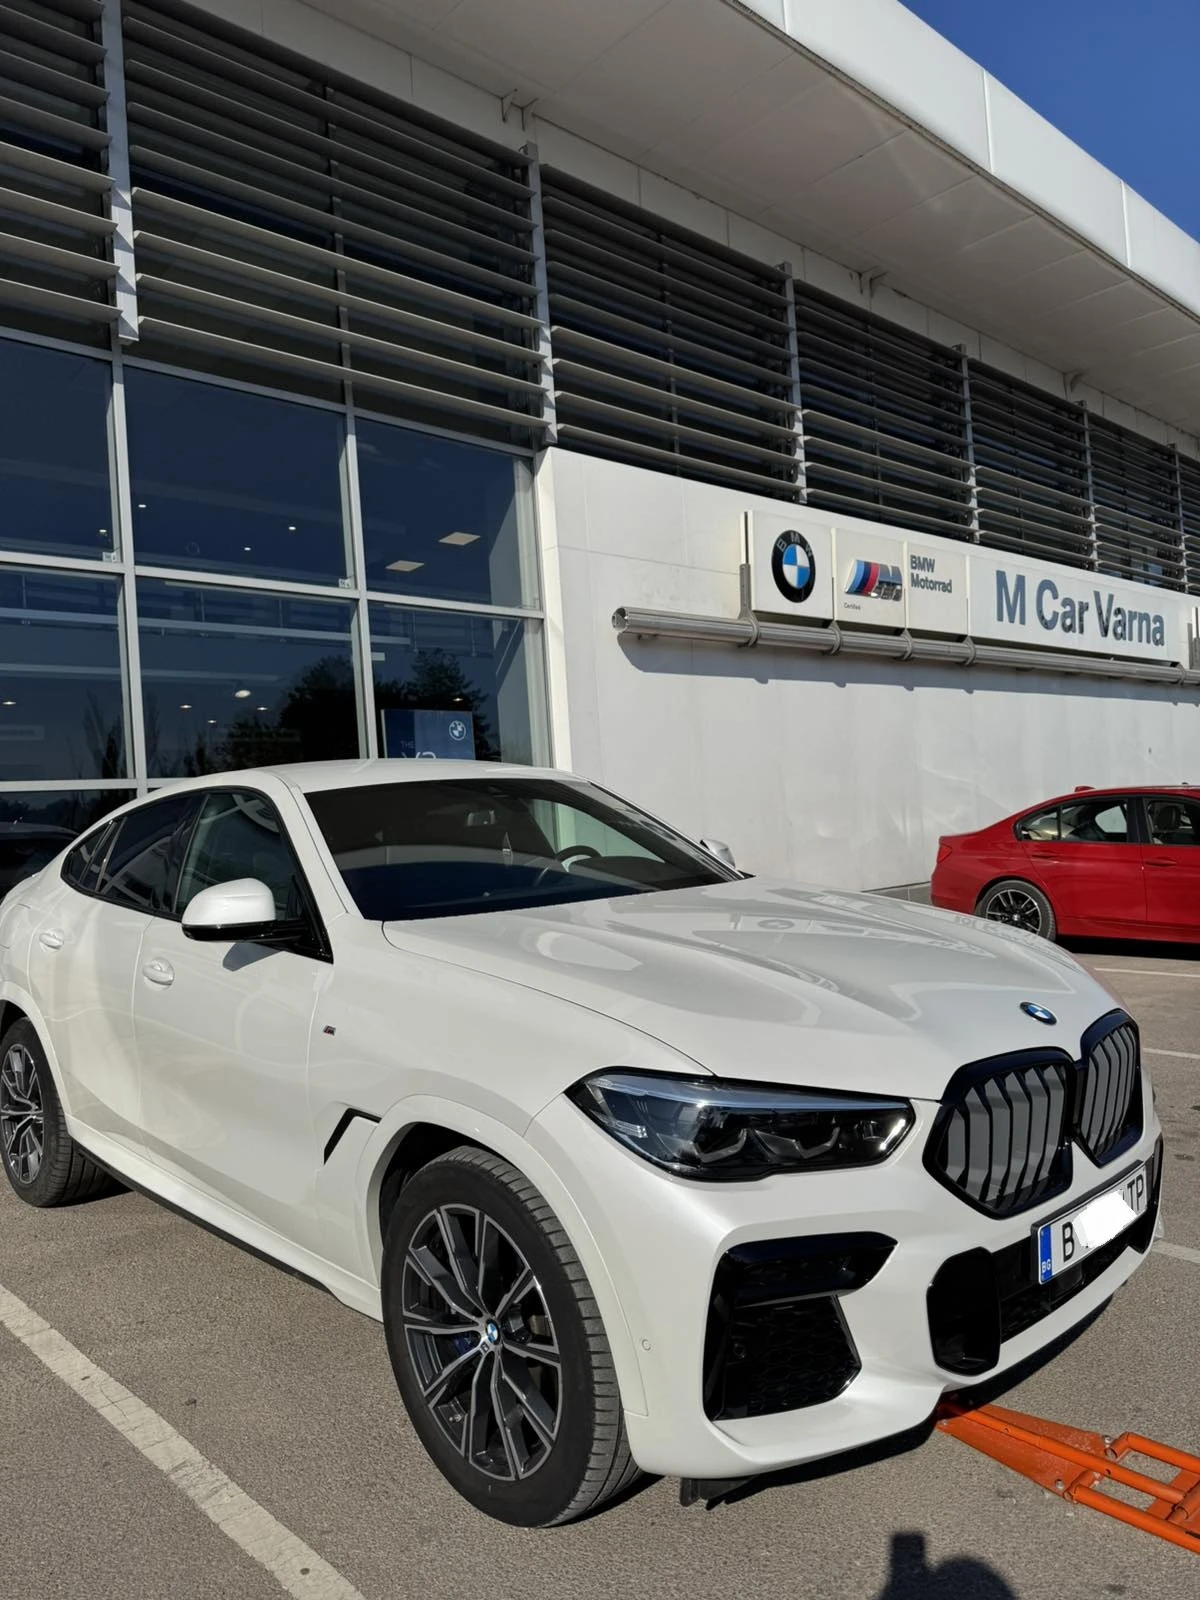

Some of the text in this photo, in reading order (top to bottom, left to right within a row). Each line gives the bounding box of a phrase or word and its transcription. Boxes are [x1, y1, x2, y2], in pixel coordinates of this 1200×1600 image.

[910, 554, 935, 573] BMW
[910, 572, 952, 594] Motorrad
[995, 569, 1165, 647] M Car Varna
[1062, 1174, 1144, 1263] B TP
[1041, 1258, 1051, 1274] BG
